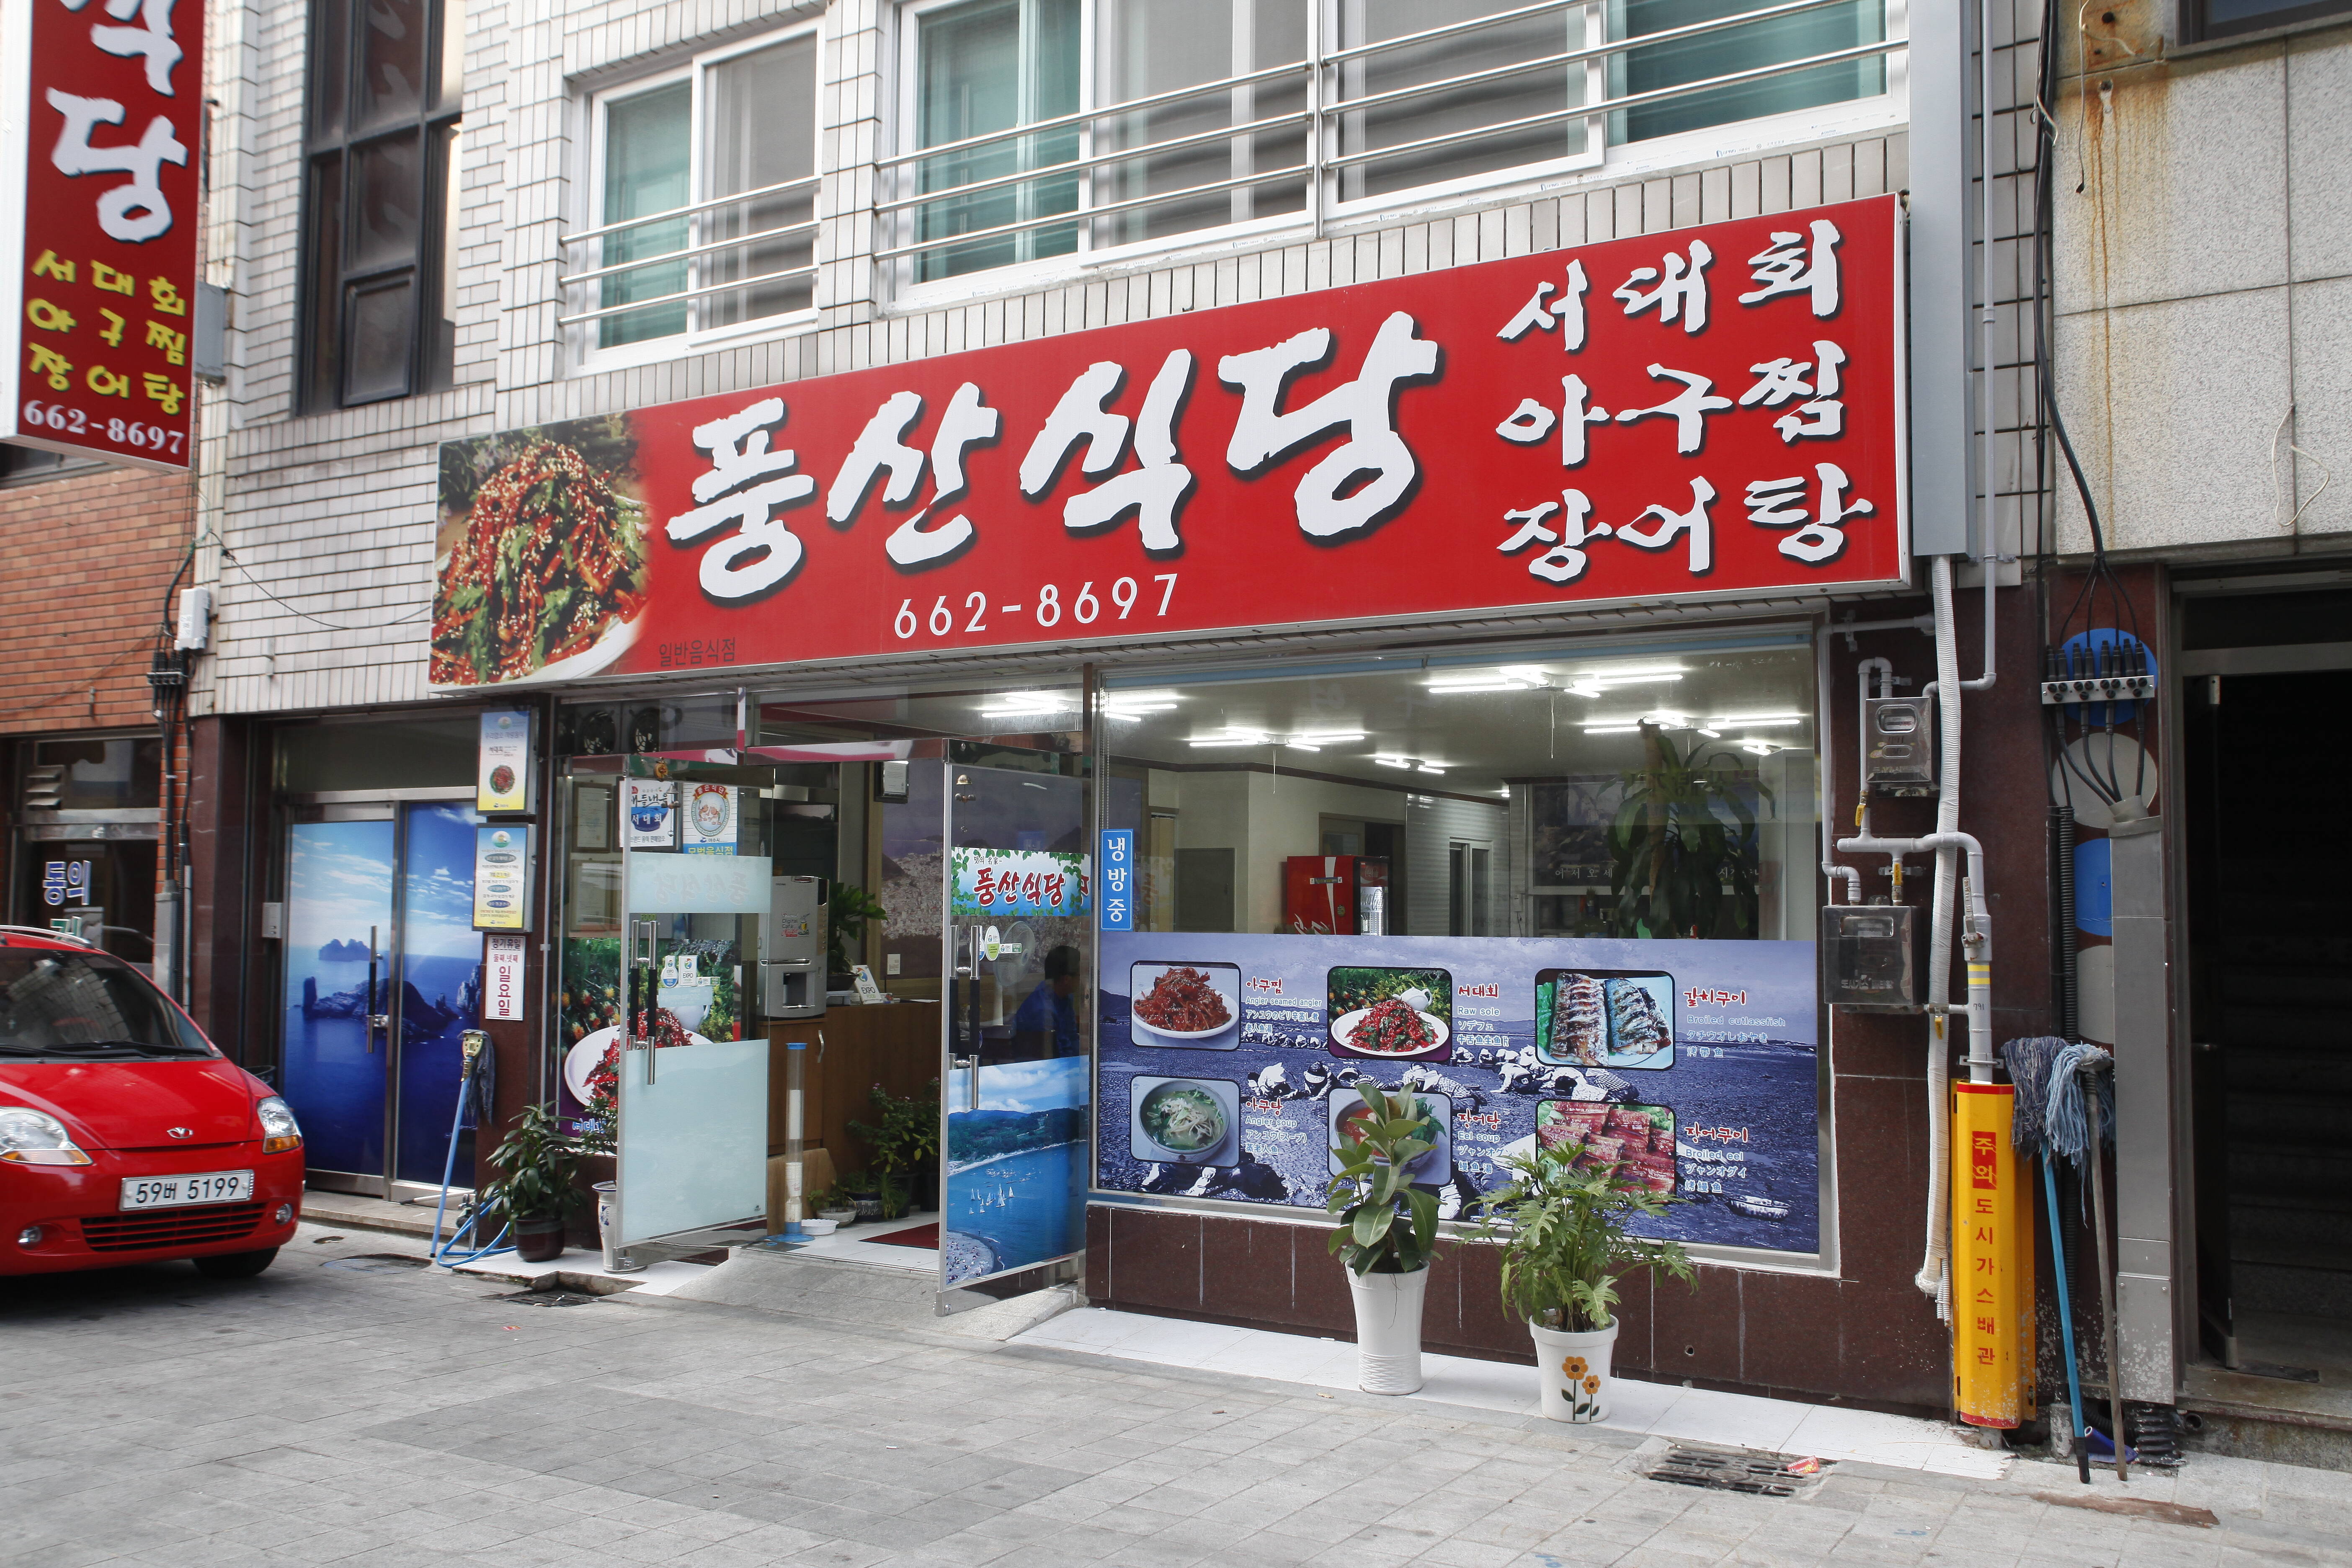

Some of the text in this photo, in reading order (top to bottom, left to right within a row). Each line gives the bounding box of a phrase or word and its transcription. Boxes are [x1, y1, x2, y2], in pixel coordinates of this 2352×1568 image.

[31, 250, 186, 317] 서대회
[1496, 219, 1840, 351] 서대회
[27, 297, 186, 366] 아구찜
[28, 341, 185, 415] 장어탕
[1496, 340, 1845, 466] 아구찜
[23, 400, 185, 454] 662-8697
[666, 311, 1438, 598] 풍산식당
[1496, 463, 1873, 581] 장어탕
[894, 573, 1178, 639] 662-8697
[659, 637, 735, 667] 일반음식점
[974, 856, 984, 864] 맛의
[973, 867, 1065, 906] 풍산식당
[1107, 837, 1127, 922] 냉방중
[492, 939, 521, 950] 정기휴일
[498, 965, 511, 1016] 일요일
[1246, 977, 1283, 994] 아구찜
[1459, 983, 1498, 998] 서대회
[1683, 987, 1746, 1007] 갈치구이
[1246, 997, 1267, 1006] Angler
[1300, 998, 1322, 1007] angler
[1480, 1007, 1500, 1016] sole
[1687, 1015, 1785, 1026] Broiled cutlassfish
[1246, 1097, 1283, 1116] 아구탕
[1458, 1109, 1501, 1130] 장어탕
[1246, 1116, 1297, 1128] Angler soup
[1684, 1122, 1748, 1144] 장어구이
[1459, 1131, 1500, 1143] Eel soup
[1686, 1149, 1744, 1161] Broiled eel
[1975, 1137, 1996, 1184] 주의
[136, 1177, 239, 1204] 59버 5199
